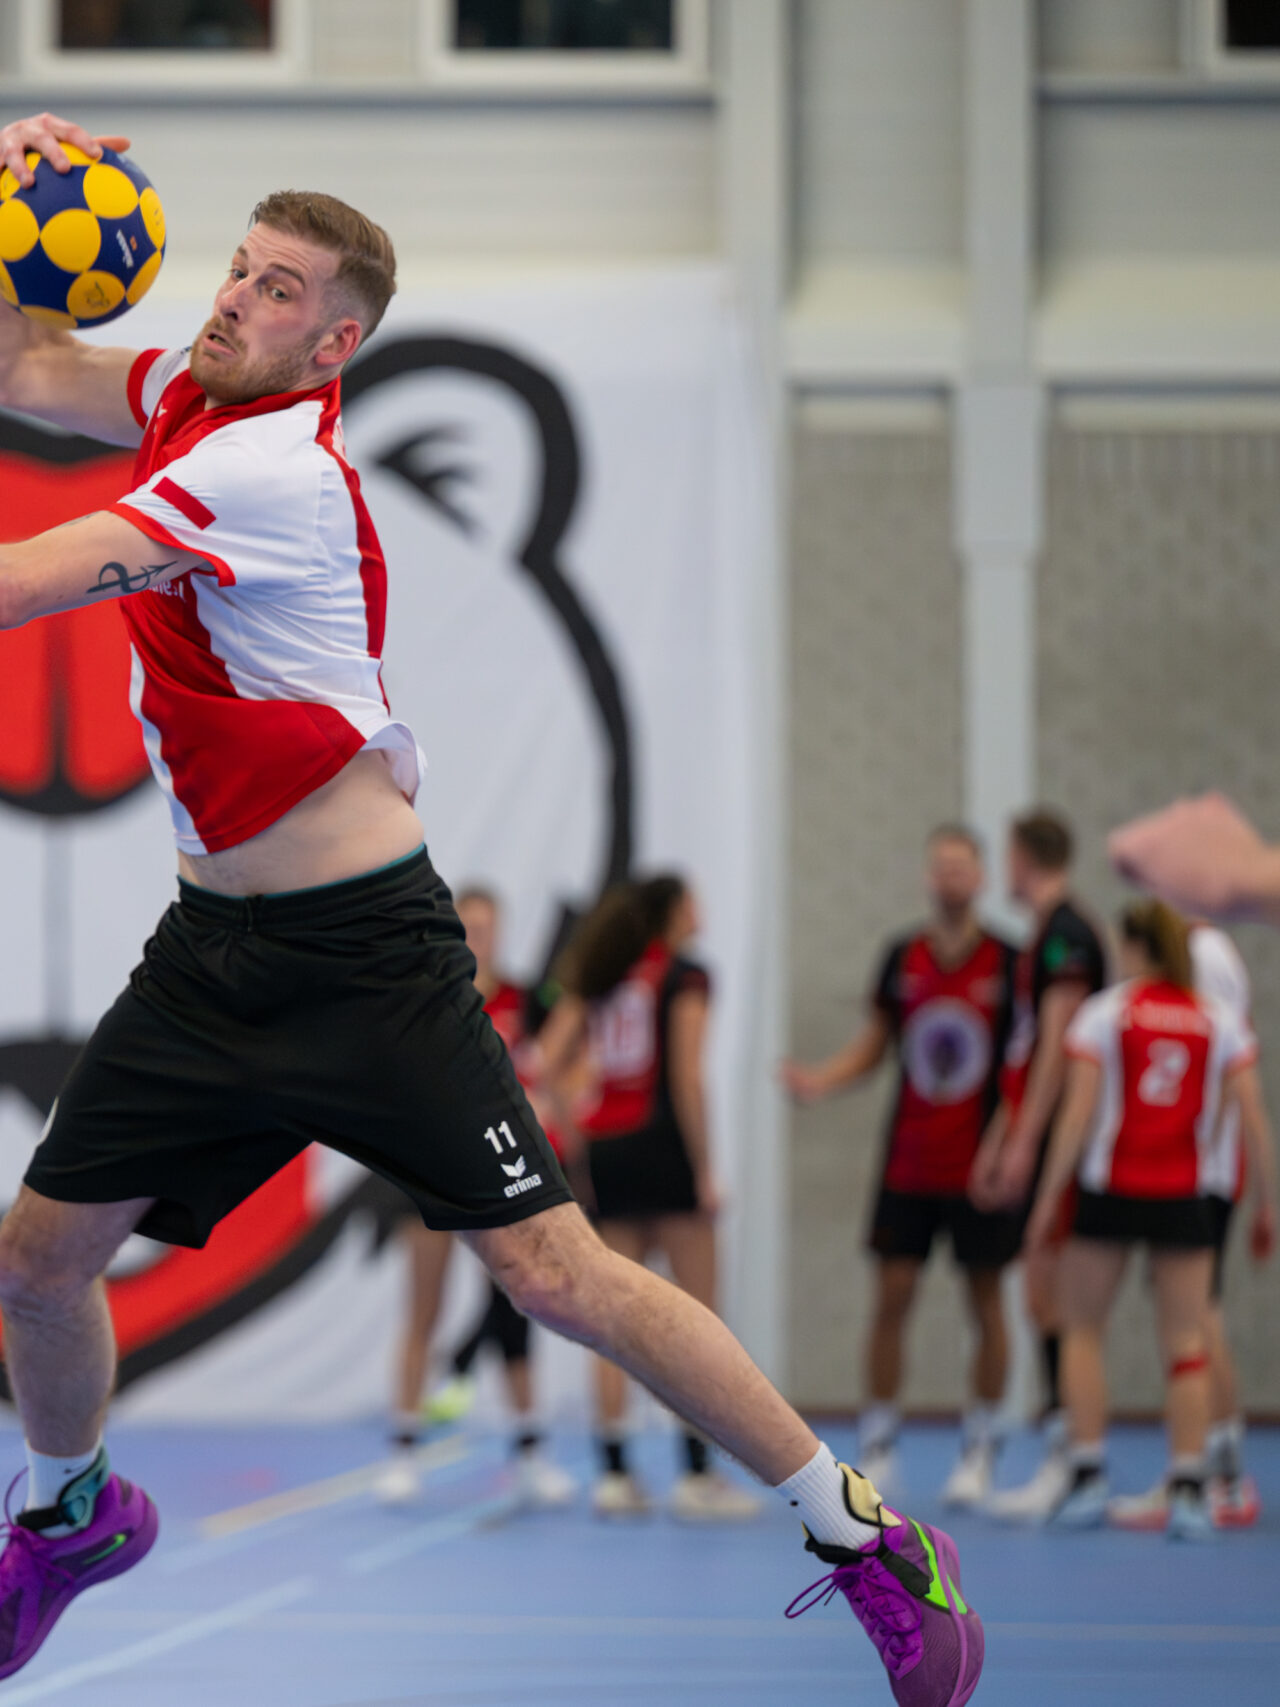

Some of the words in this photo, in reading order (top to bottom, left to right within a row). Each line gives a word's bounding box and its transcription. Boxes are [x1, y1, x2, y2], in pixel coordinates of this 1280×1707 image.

[1137, 1037, 1191, 1107] 2
[483, 1120, 517, 1154] 11
[503, 1174, 543, 1199] erima
